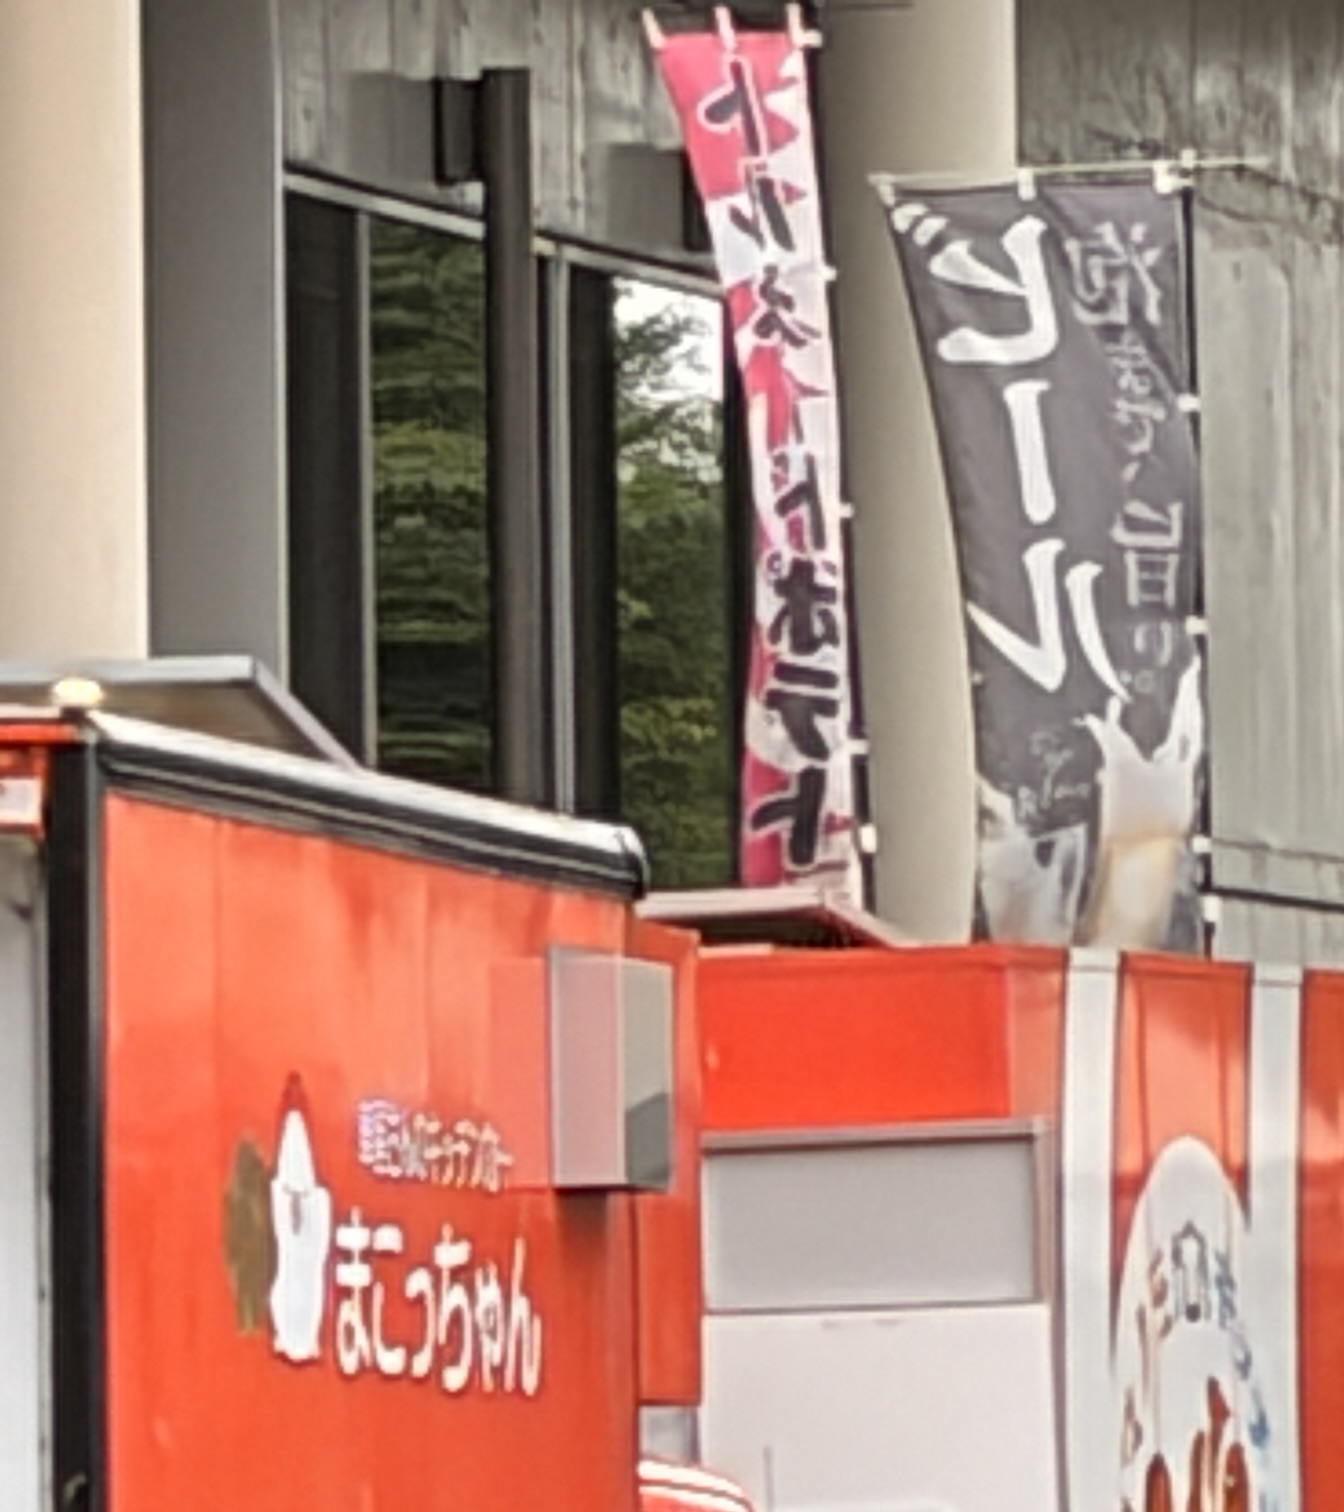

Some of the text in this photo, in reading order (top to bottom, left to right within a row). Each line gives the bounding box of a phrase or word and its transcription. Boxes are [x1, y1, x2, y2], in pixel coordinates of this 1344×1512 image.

[335, 1206, 543, 1396] まこっちゃん
